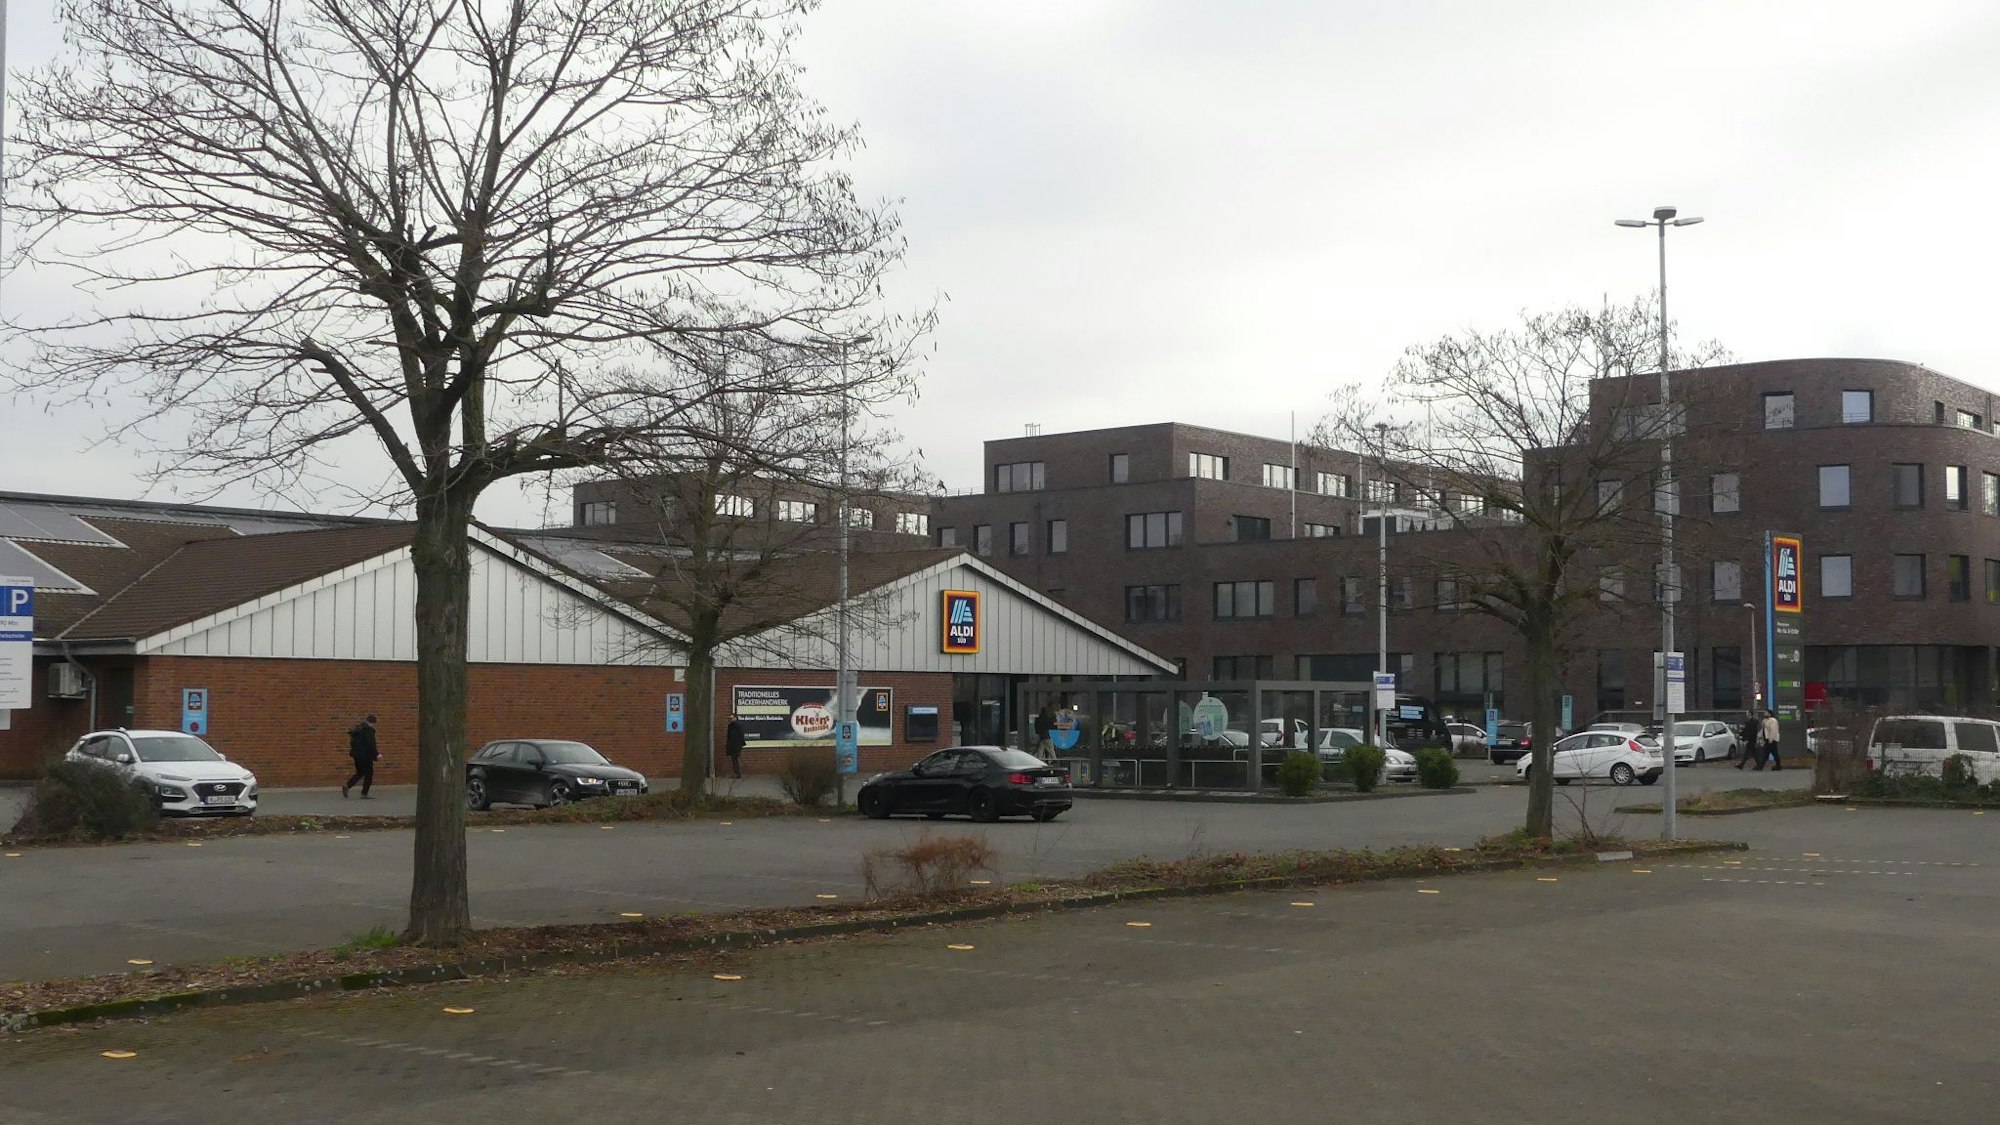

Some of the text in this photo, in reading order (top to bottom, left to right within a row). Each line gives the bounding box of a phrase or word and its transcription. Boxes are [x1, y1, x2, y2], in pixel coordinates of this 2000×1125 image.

[1778, 580, 1796, 593] ALDI
[11, 589, 29, 613] P
[950, 625, 973, 637] ALDI
[738, 698, 788, 706] BÄCKERHANDWERK
